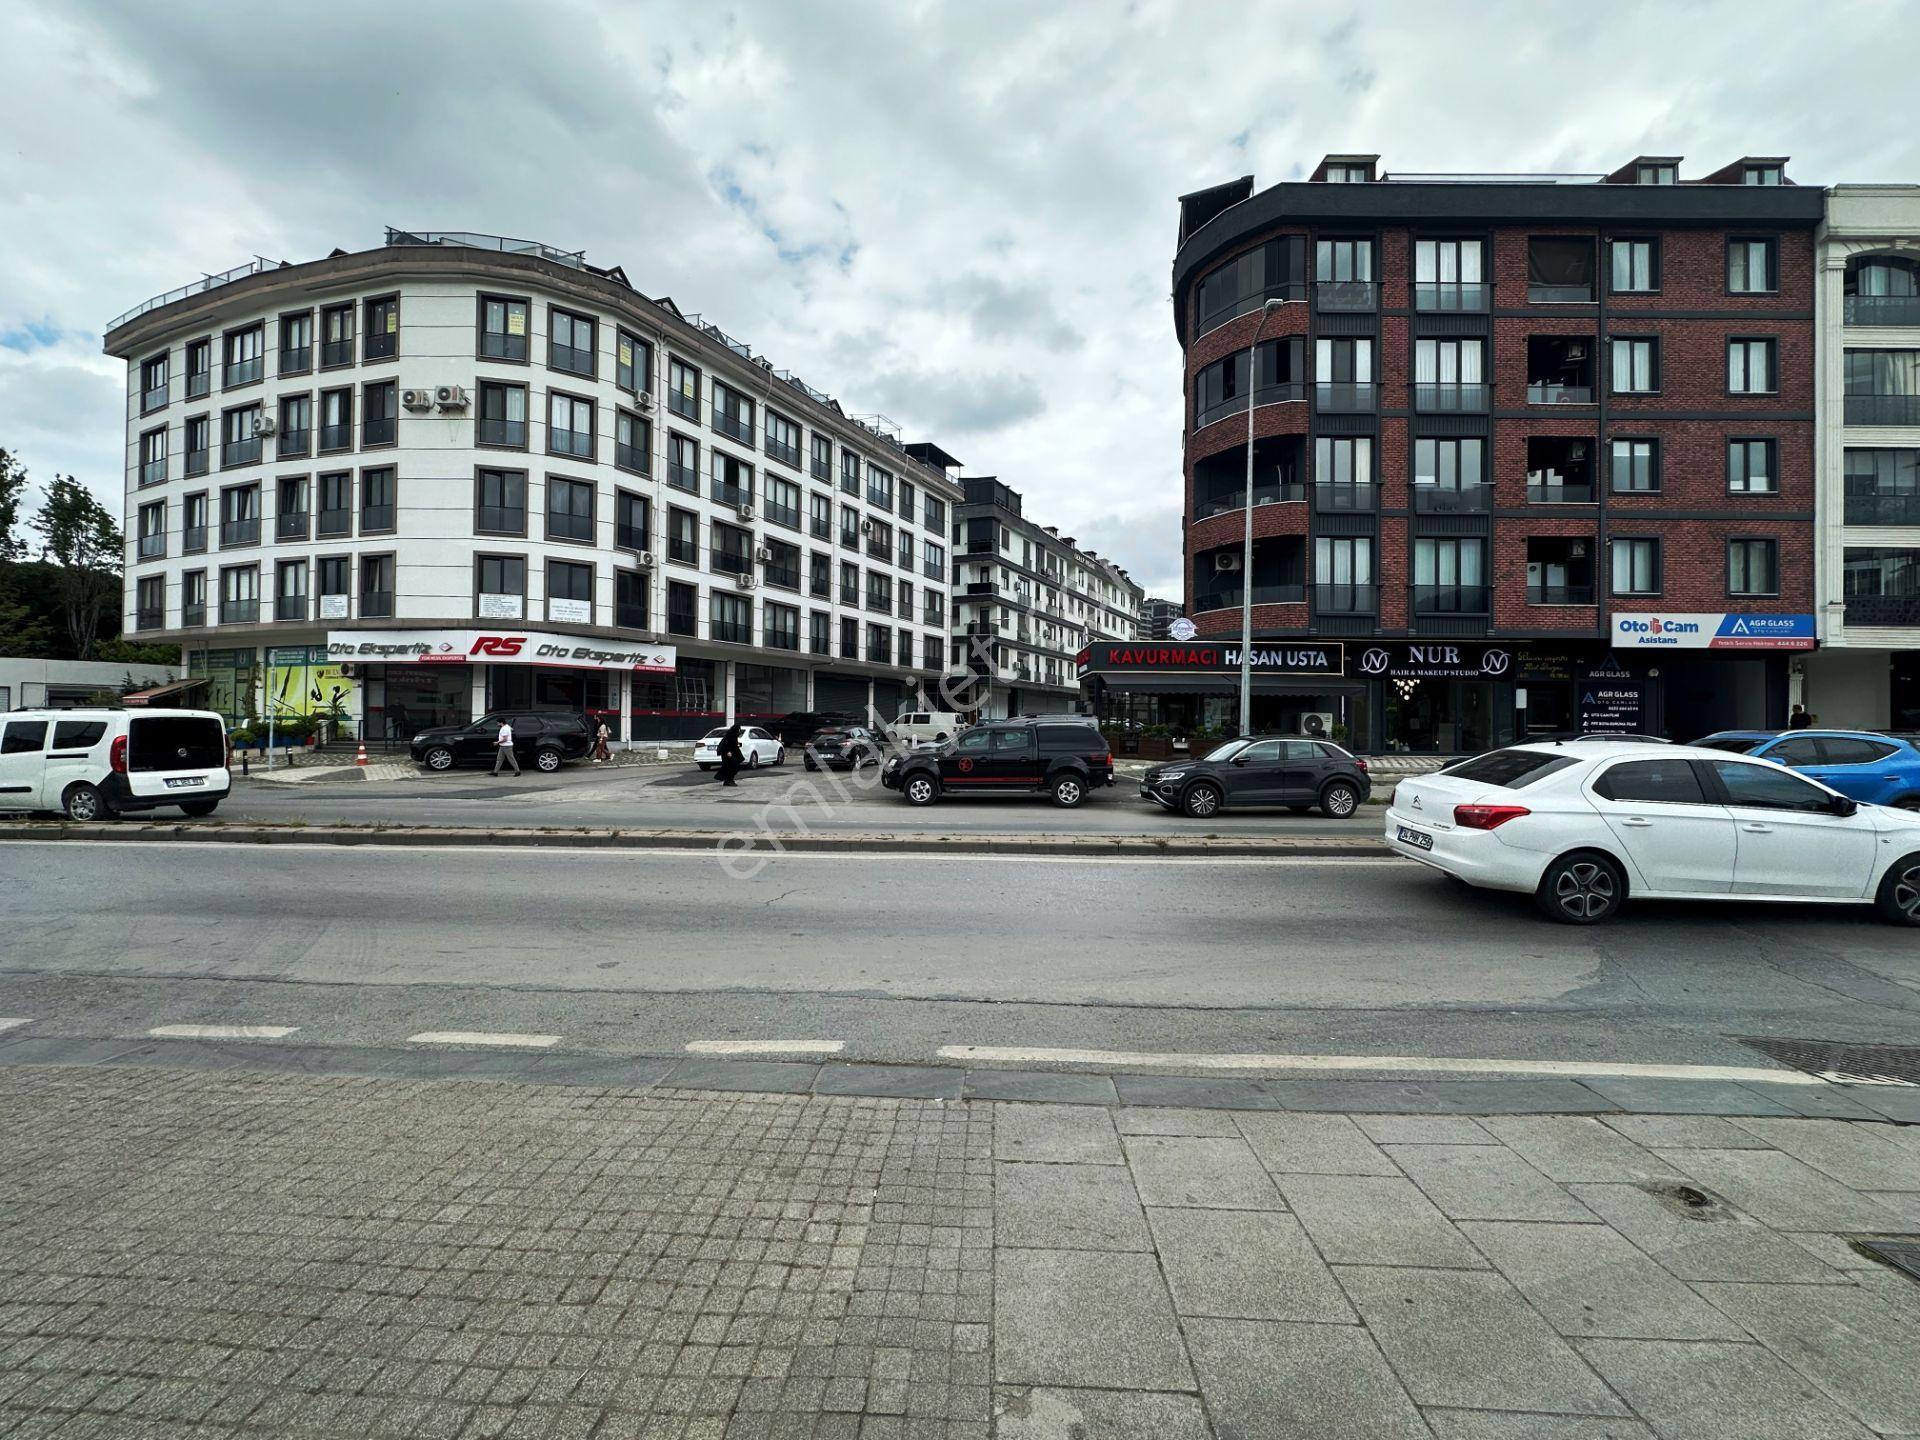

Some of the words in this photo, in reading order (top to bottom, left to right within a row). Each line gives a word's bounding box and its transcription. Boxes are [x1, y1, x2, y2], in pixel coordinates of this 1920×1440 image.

[1619, 620, 1649, 632] Oto
[1663, 620, 1699, 633] Cam
[469, 636, 528, 656] RS
[1638, 636, 1678, 644] Asistans
[328, 642, 355, 655] Oto
[357, 642, 432, 659] Ekspertiz
[536, 644, 570, 658] Oto
[571, 647, 648, 665] Ekspertiz
[1109, 649, 1217, 665] KAVURMACI
[1287, 650, 1329, 666] USTA
[1408, 646, 1461, 664] NUR
[1417, 669, 1450, 677] MAKEUP
[1589, 670, 1605, 678] AGR
[1606, 670, 1631, 678] GLASS
